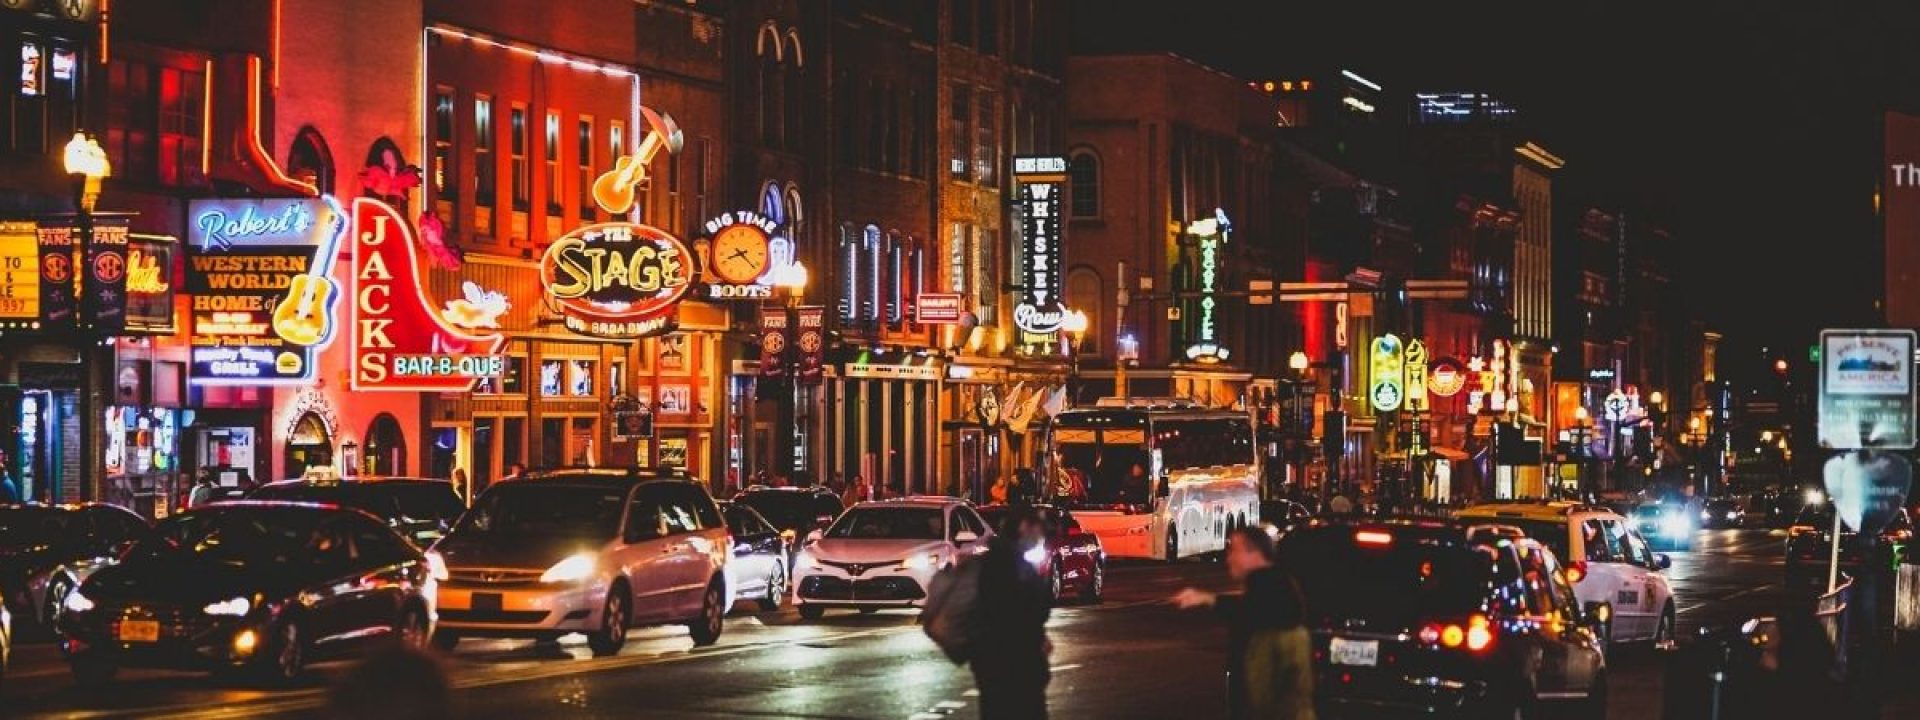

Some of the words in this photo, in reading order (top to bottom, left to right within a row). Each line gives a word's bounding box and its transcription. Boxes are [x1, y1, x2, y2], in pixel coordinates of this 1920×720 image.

[198, 202, 310, 253] Robert's
[705, 212, 733, 233] BIG
[736, 211, 777, 234] TIME
[39, 233, 72, 246] FANS
[93, 233, 128, 245] FANS
[602, 226, 633, 242] THE
[1029, 183, 1051, 306] WHISKEY
[4, 256, 22, 269] TO
[191, 255, 307, 272] WESTERN
[551, 238, 687, 298] STAGE
[208, 273, 291, 289] WORLD
[709, 284, 772, 297] BOOTS
[193, 295, 263, 311] HOME
[359, 216, 396, 383] JACKS
[566, 315, 587, 331] ON
[591, 316, 667, 334] BROADWAY
[1015, 302, 1063, 333] Row
[393, 356, 502, 376] BAR-B-QUE
[1838, 373, 1900, 381] AMERICA
